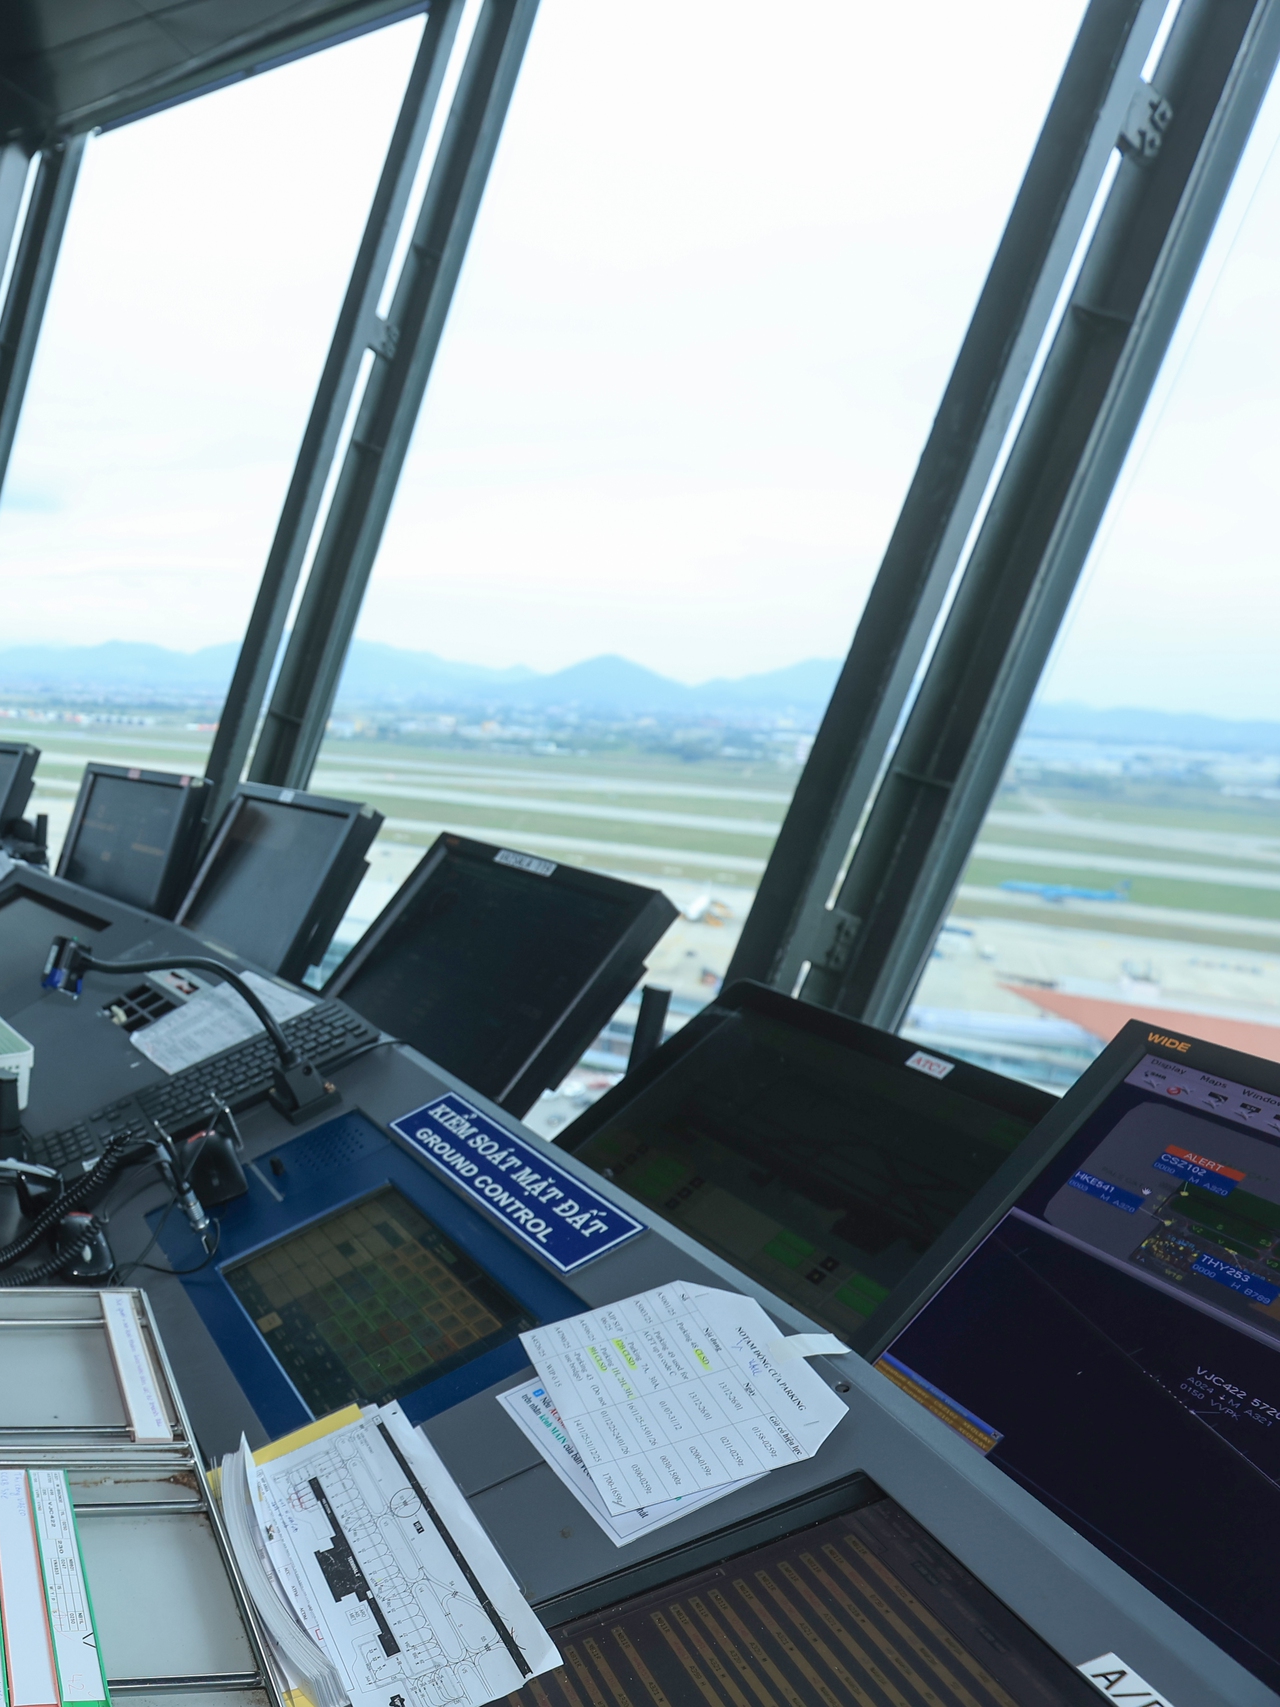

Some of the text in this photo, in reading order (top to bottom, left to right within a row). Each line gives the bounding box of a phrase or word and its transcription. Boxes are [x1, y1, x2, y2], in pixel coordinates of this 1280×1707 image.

[1147, 1031, 1192, 1053] WIDE
[1150, 1058, 1187, 1075] Display
[1200, 1075, 1228, 1089] Maps
[428, 1104, 609, 1238] KIỂM SOÁT MẶT ĐẤT
[1161, 1153, 1207, 1176] CSZ102
[1183, 1152, 1225, 1172] ALERT
[415, 1127, 554, 1244] GROUND CONTROL
[1075, 1171, 1115, 1193] HKE541
[1201, 1253, 1251, 1283] THY253
[597, 1346, 617, 1367] Parking
[625, 1341, 645, 1361] Parking
[641, 1330, 657, 1346] ACFT
[659, 1358, 673, 1371] code
[650, 1330, 672, 1351] Parking
[670, 1358, 684, 1371] used
[679, 1371, 691, 1380] for
[673, 1321, 696, 1342] Parking
[693, 1348, 711, 1365] CLSD
[593, 1354, 608, 1371] CLSD
[620, 1349, 637, 1366] CLSD
[733, 1326, 759, 1350] NOTAM
[777, 1381, 808, 1411] PARKING
[589, 1383, 602, 1396] (Do
[596, 1396, 607, 1406] not
[1197, 1366, 1247, 1400] VJC422
[1180, 1383, 1241, 1421] 0150 VVPK
[1187, 1377, 1215, 1394] A024
[1243, 1409, 1273, 1427] A321
[548, 1424, 567, 1446] MAIN
[47, 1501, 55, 1527] VJC422
